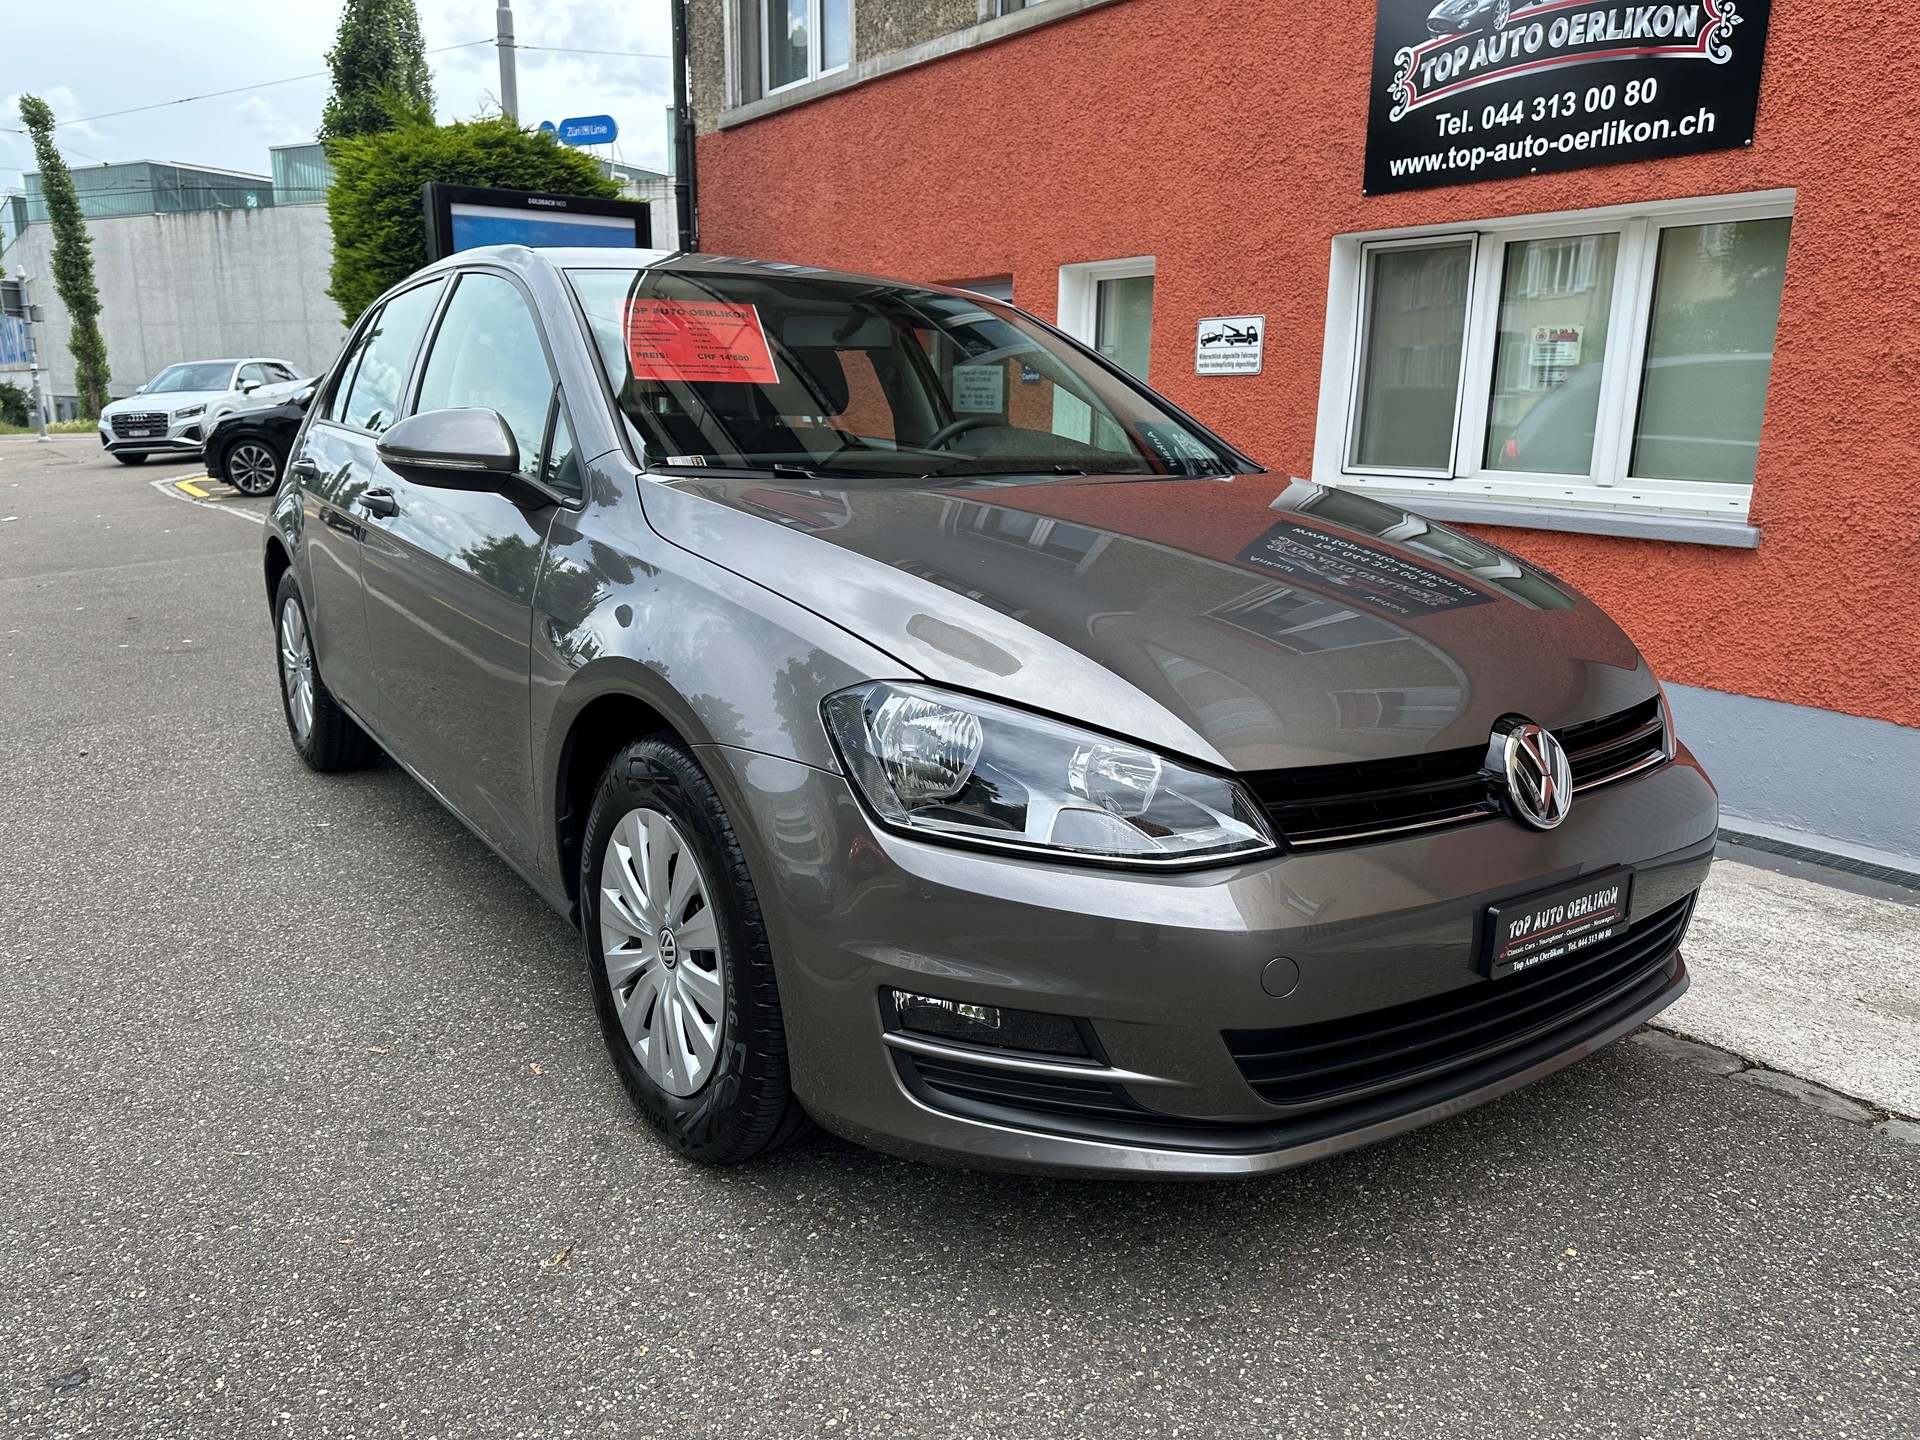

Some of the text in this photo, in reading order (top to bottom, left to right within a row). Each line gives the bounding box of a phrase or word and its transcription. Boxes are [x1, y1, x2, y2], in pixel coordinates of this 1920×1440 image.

[1421, 5, 1699, 89] TOP AUTO OERLIKON
[1435, 77, 1658, 137] Tel. 044 313 00 80
[1389, 107, 1716, 177] www.top-auto-oerlikon.ch
[652, 307, 686, 317] AUTO
[688, 308, 751, 319] OERLIKON
[636, 352, 669, 360] PREIS:
[697, 353, 717, 361] CHF
[581, 774, 615, 874] Continetal
[1509, 886, 1619, 939] TOP AUTO OERLIKON
[1507, 945, 1525, 957] Classic
[1525, 942, 1536, 951] Cars
[1513, 961, 1524, 971] Top
[1525, 957, 1539, 967] Auto
[1539, 946, 1564, 962] Oerlikon
[1567, 941, 1578, 951] Tel.
[1578, 937, 1588, 947] 044
[1588, 933, 1598, 944] 313
